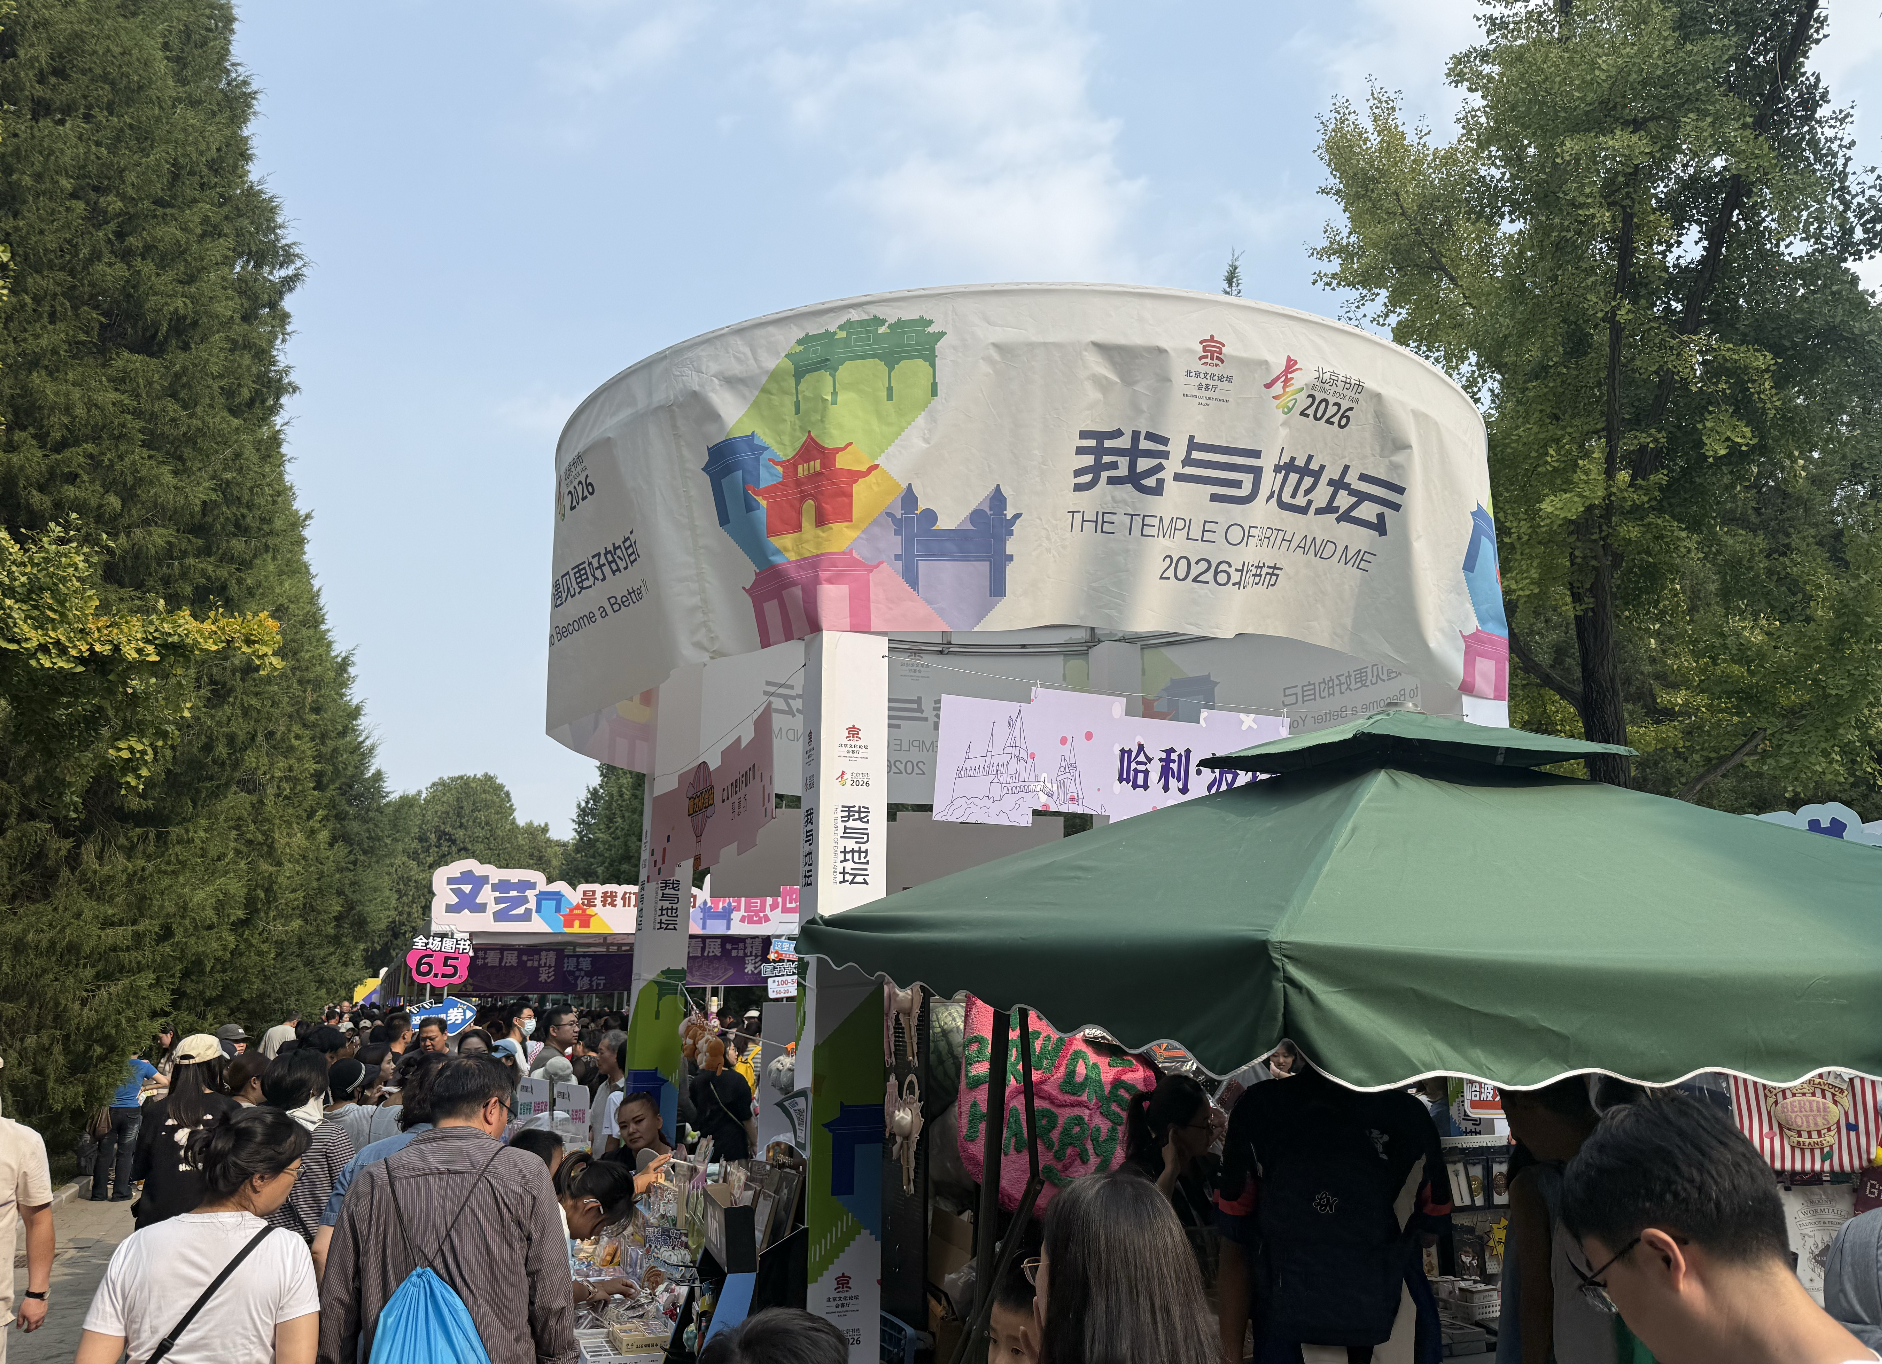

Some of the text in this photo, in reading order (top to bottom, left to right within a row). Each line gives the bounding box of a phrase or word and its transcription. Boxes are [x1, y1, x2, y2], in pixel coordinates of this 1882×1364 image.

[1184, 369, 1234, 384] 北京文化论坛
[1196, 382, 1218, 393] 会客厅
[1314, 366, 1365, 396] 北京书市
[1299, 393, 1354, 430] 2026
[567, 473, 595, 511] 2026
[1072, 427, 1406, 538] 我与地坛
[1067, 510, 1117, 535] THE
[1123, 512, 1219, 544] TEMPLE
[1293, 535, 1337, 560] AND
[1338, 544, 1377, 573] ME
[552, 528, 640, 609] 遇见更好的自
[554, 610, 597, 643] Become
[597, 605, 609, 619] a
[850, 779, 870, 787] 2026
[1117, 744, 1272, 796] 哈利·波
[839, 805, 870, 886] 我与地坛
[445, 869, 537, 924] 文艺
[657, 879, 680, 931] 我与地坛
[412, 934, 472, 954] 全场图书
[485, 951, 518, 967] 看展
[688, 938, 722, 956] 看展
[744, 938, 763, 974] 精彩
[415, 953, 460, 979] 6.5
[539, 951, 556, 983] 精彩
[563, 957, 592, 972] 提笔
[577, 975, 606, 990] 修行
[1808, 1077, 1845, 1096] FLAVOUR
[1781, 1099, 1830, 1114] BERTIE
